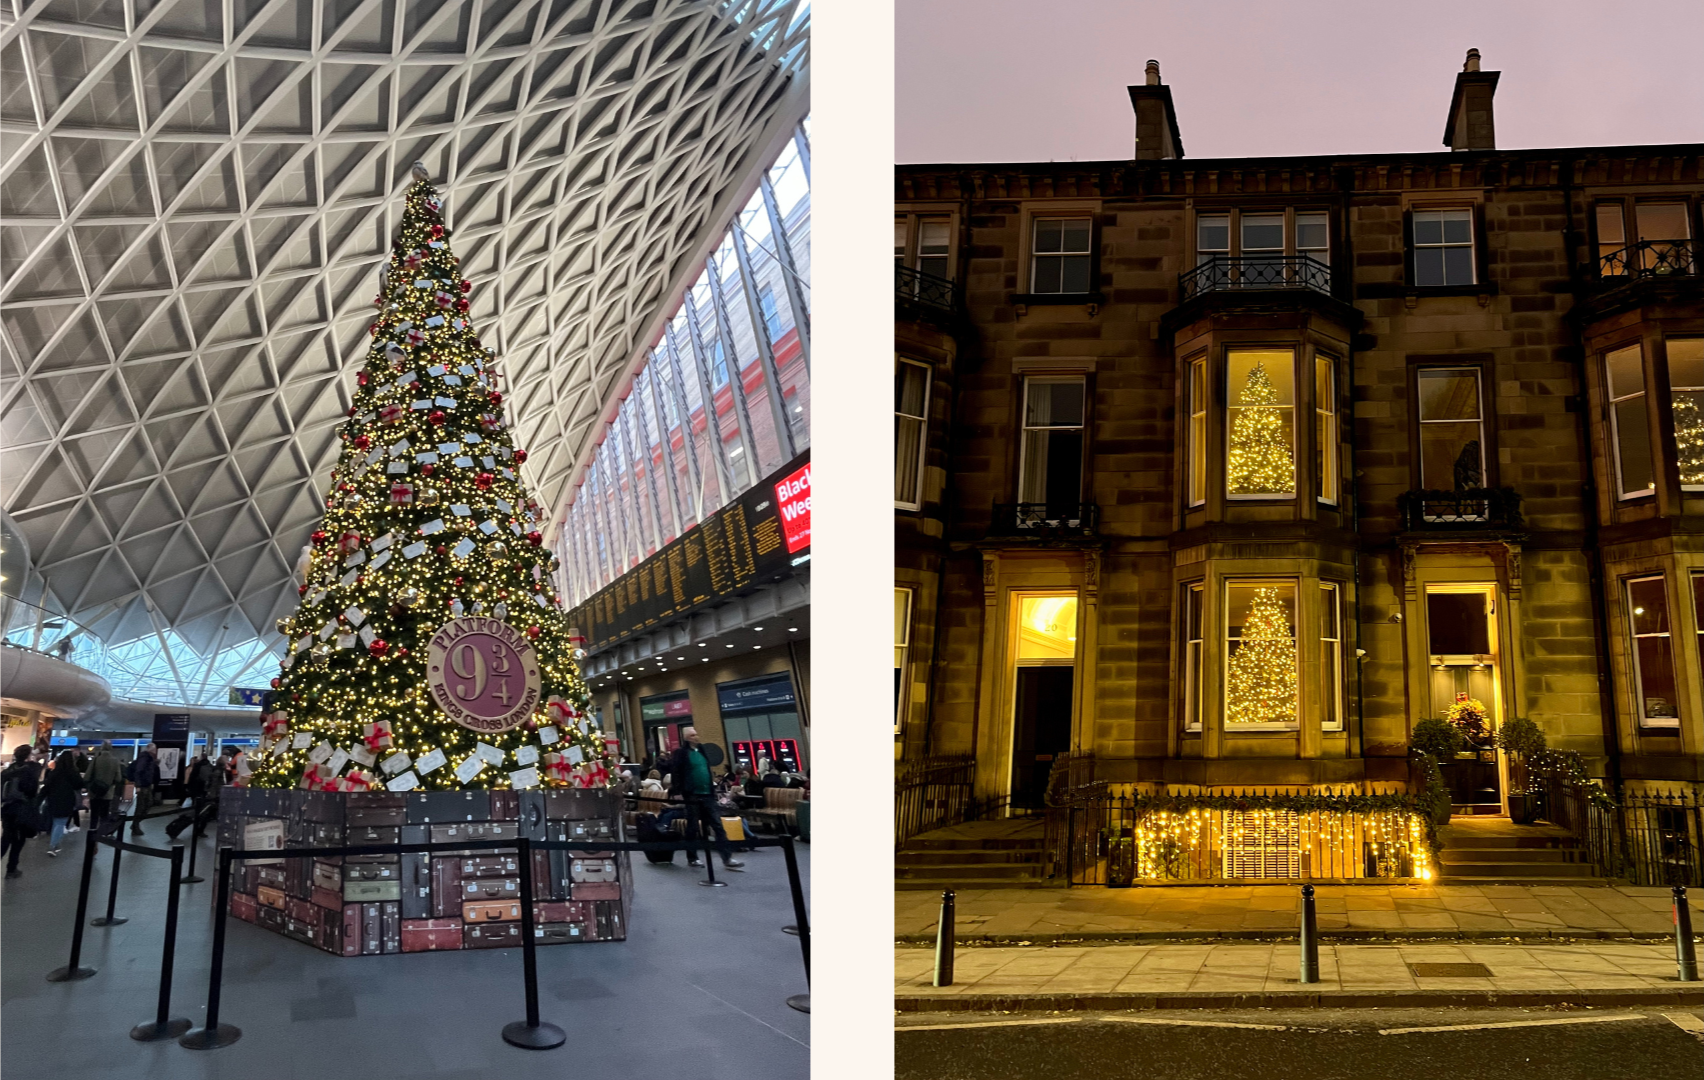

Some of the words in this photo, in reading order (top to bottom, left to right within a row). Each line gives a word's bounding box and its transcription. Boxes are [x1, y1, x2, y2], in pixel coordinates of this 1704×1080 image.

[432, 617, 531, 656] PLATFORM
[451, 643, 487, 701] 9
[434, 683, 463, 718] KINGS
[463, 714, 503, 730] CROSS
[503, 687, 537, 726] LONDON
